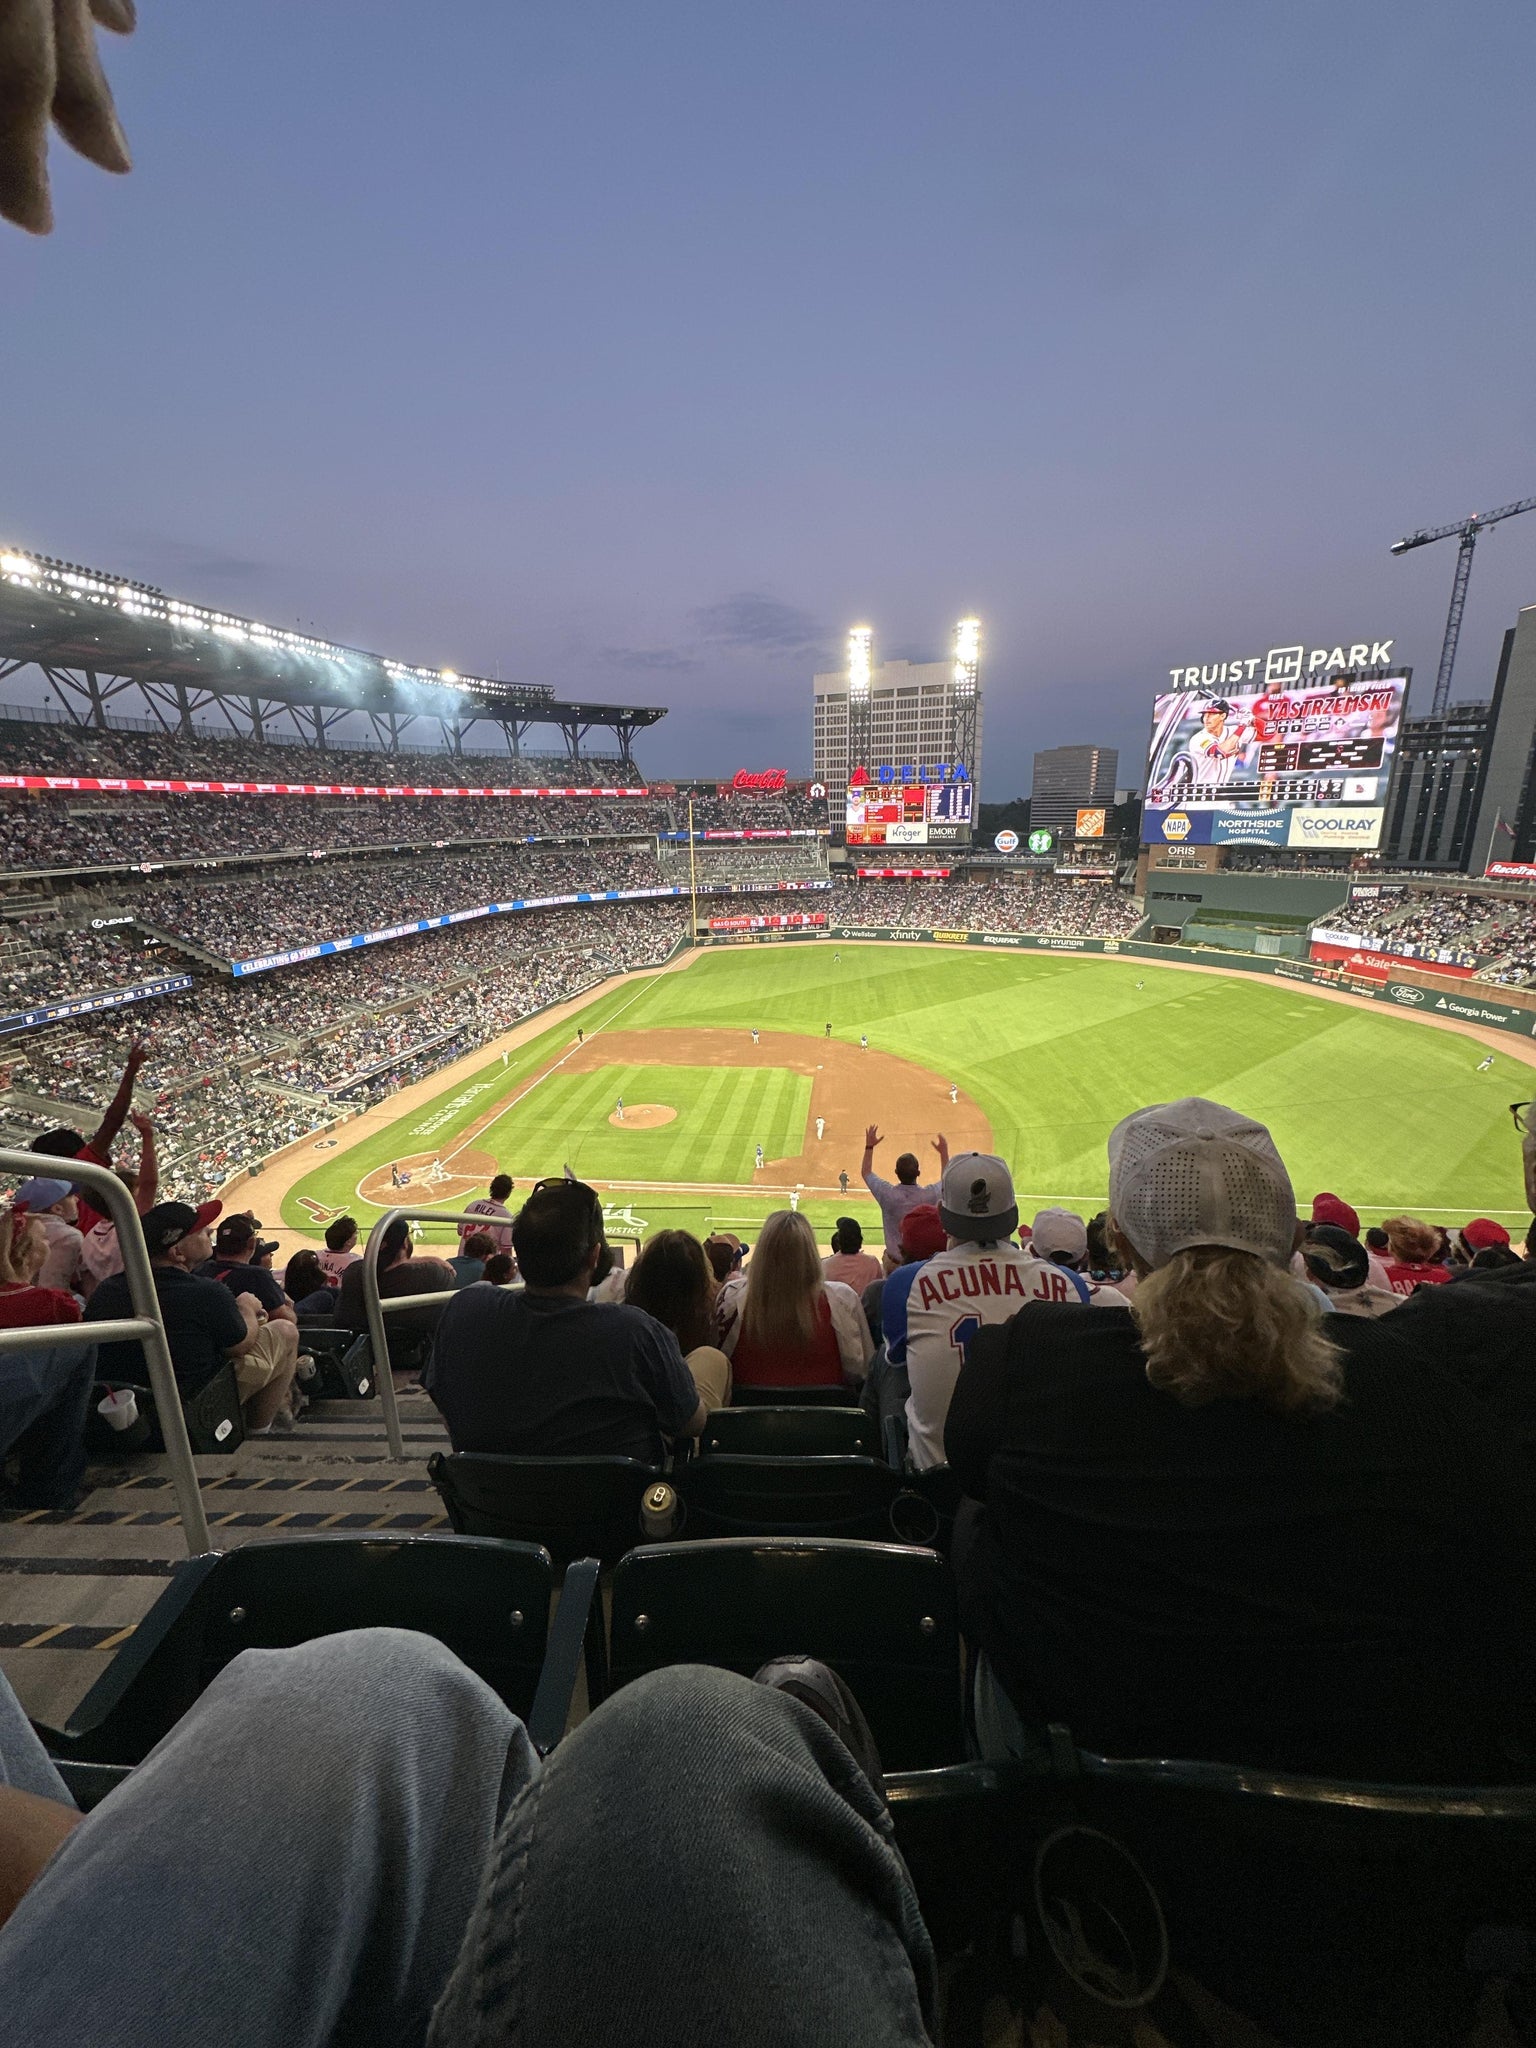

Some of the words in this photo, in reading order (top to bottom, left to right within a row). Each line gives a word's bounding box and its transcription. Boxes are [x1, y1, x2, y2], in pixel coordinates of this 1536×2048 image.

[1170, 658, 1261, 688] TRUIST
[1309, 640, 1394, 672] PARK
[1268, 691, 1393, 720] YASTRZEMSKI
[733, 768, 788, 789] Coca-Cola
[879, 763, 969, 782] DELTA
[1320, 782, 1328, 792] 3
[1332, 782, 1340, 792] 2
[1077, 811, 1103, 835] HOME
[1167, 820, 1186, 833] NAPA
[1218, 820, 1284, 828] NORTHSIDE
[1303, 819, 1376, 830] COOLRAY
[893, 825, 921, 841] Kroger
[929, 828, 958, 836] EMORY
[1168, 846, 1195, 855] ORIS
[103, 917, 134, 925] LEXUS
[364, 929, 396, 943] CELEBRATING
[890, 930, 921, 941] xfinity
[933, 930, 969, 940] QUIKRETE
[983, 936, 1021, 945] EQUIFAX
[1325, 932, 1349, 942] COOLRAY
[1051, 939, 1084, 947] HYUNDAI
[241, 954, 290, 972] CELEBRATING
[290, 951, 299, 961] 60
[299, 946, 321, 959] YEARS!
[1365, 955, 1391, 970] State
[1395, 986, 1418, 1000] Ford
[1449, 1002, 1479, 1017] Georgia
[1481, 1010, 1508, 1023] Power
[475, 1204, 497, 1216] RILEY
[919, 1258, 1026, 1311] ACUÑA
[1033, 1271, 1068, 1303] JR
